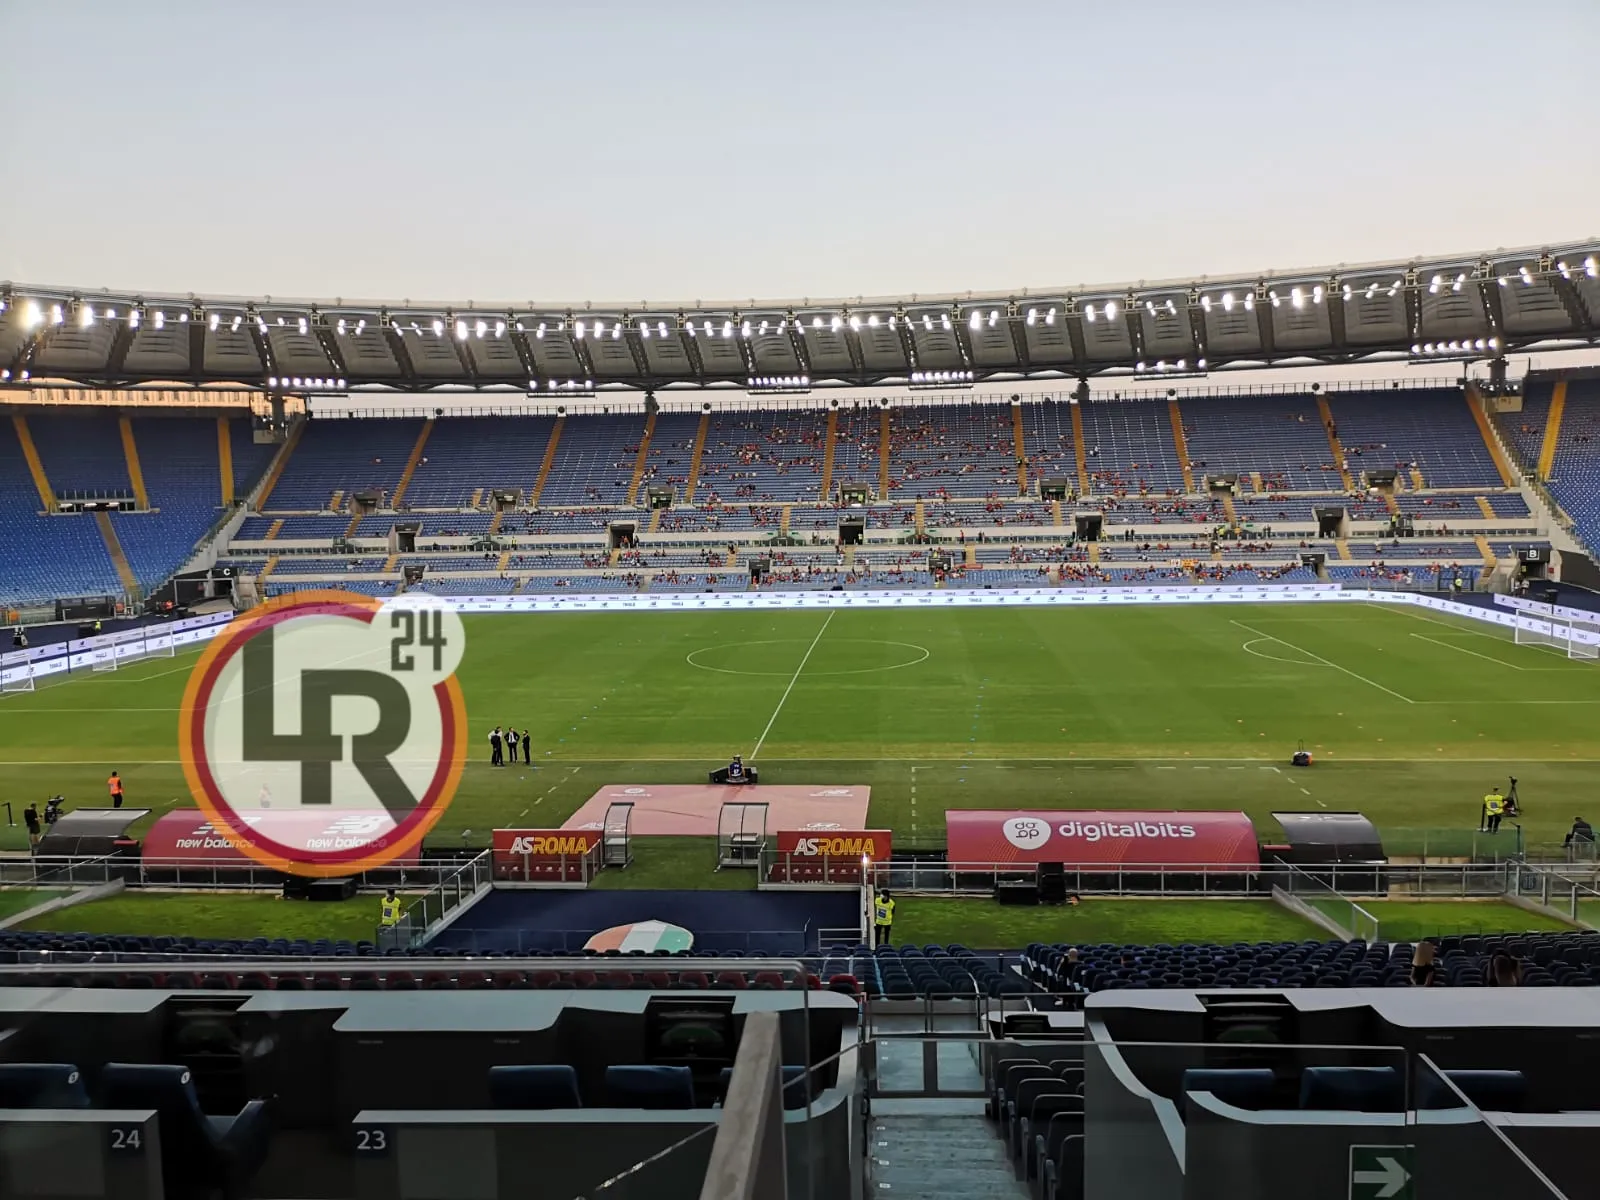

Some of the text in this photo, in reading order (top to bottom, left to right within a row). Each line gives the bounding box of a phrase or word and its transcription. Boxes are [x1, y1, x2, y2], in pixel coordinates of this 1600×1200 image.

[1529, 549, 1537, 558] B
[223, 568, 231, 576] C
[1058, 822, 1196, 841] digitalbits
[176, 839, 203, 848] new
[306, 838, 334, 848] new
[111, 1129, 141, 1149] 24
[356, 1130, 386, 1150] 23
